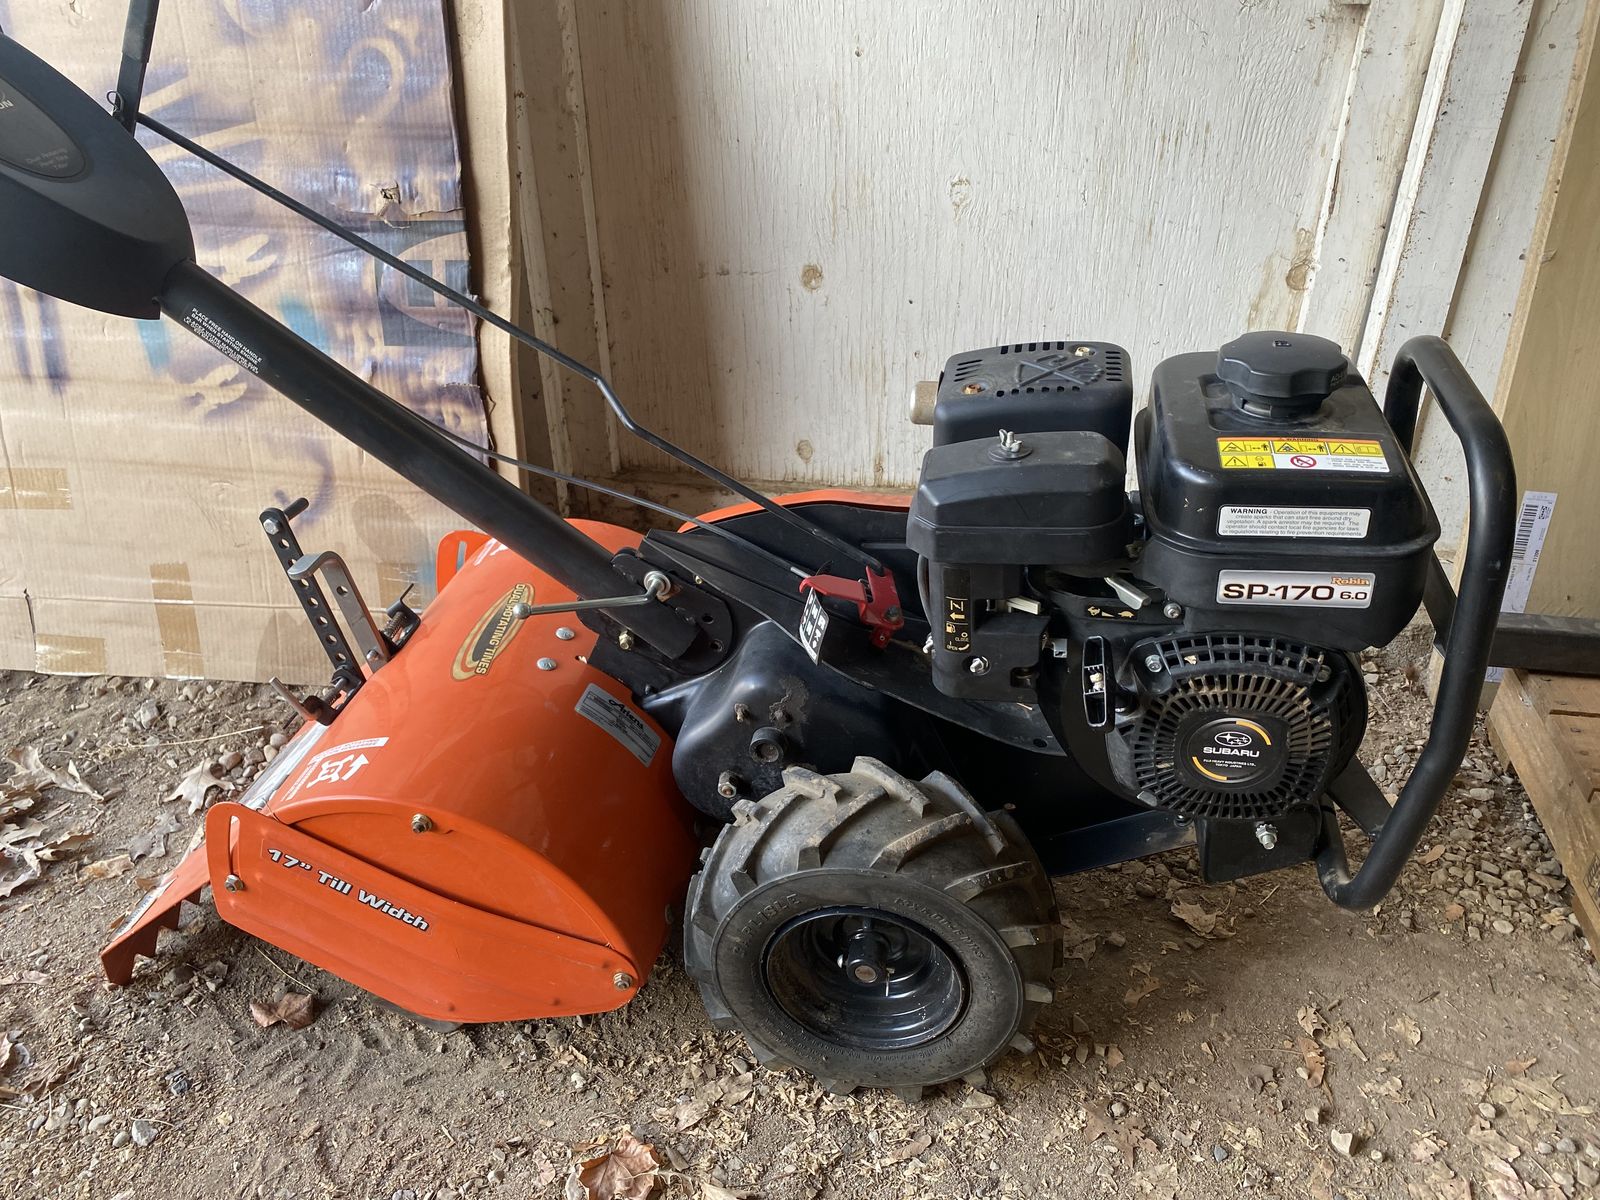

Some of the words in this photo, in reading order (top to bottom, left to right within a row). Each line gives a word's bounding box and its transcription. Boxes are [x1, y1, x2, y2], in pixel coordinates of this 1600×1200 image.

[190, 313, 202, 323] BAR
[201, 321, 216, 334] WHEN
[216, 332, 240, 351] STARTING
[239, 349, 258, 364] ENGINE
[192, 307, 208, 322] PLACE
[208, 319, 221, 331] FREE
[220, 330, 235, 342] HAND
[242, 346, 262, 362] HANDLE
[507, 583, 526, 607] DUAL
[1223, 583, 1335, 600] SP-170
[1340, 591, 1367, 600] 6.0
[1331, 576, 1370, 586] Robin
[489, 606, 514, 646] ROTATING
[476, 645, 496, 675] TINES
[608, 700, 644, 730] Ariens
[1203, 746, 1260, 758] SUBARU
[318, 870, 353, 896] Till
[357, 889, 429, 932] Width
